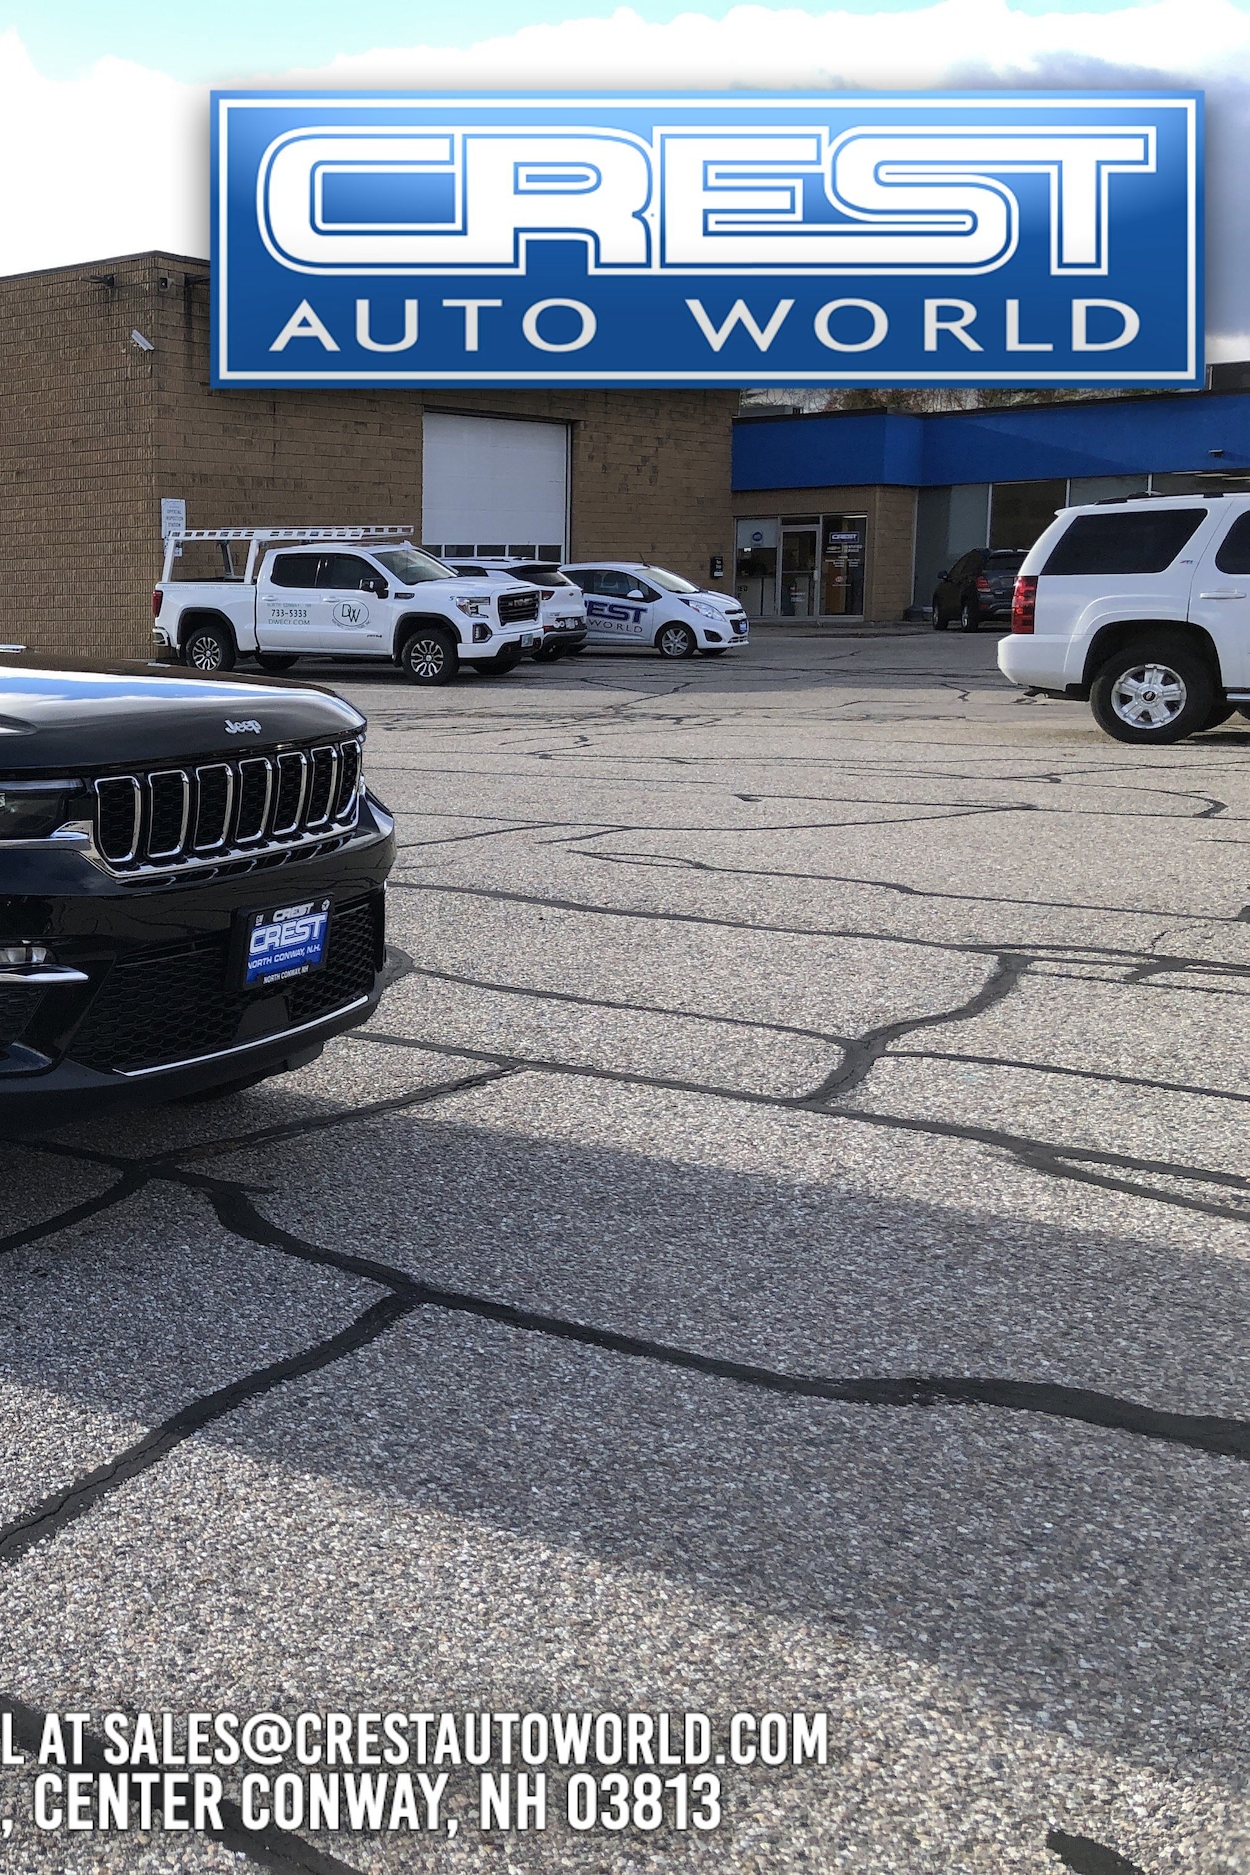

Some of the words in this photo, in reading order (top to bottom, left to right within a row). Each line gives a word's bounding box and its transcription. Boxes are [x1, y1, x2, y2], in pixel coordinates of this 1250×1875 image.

[271, 608, 308, 618] 733-5333
[585, 600, 648, 624] EST
[588, 619, 644, 634] WORLD
[224, 718, 262, 735] Jeep
[272, 902, 315, 922] CREST
[249, 912, 328, 956] CREST
[247, 956, 273, 970] NORTH
[273, 947, 306, 963] CONWAY,
[263, 973, 281, 984] NORTH
